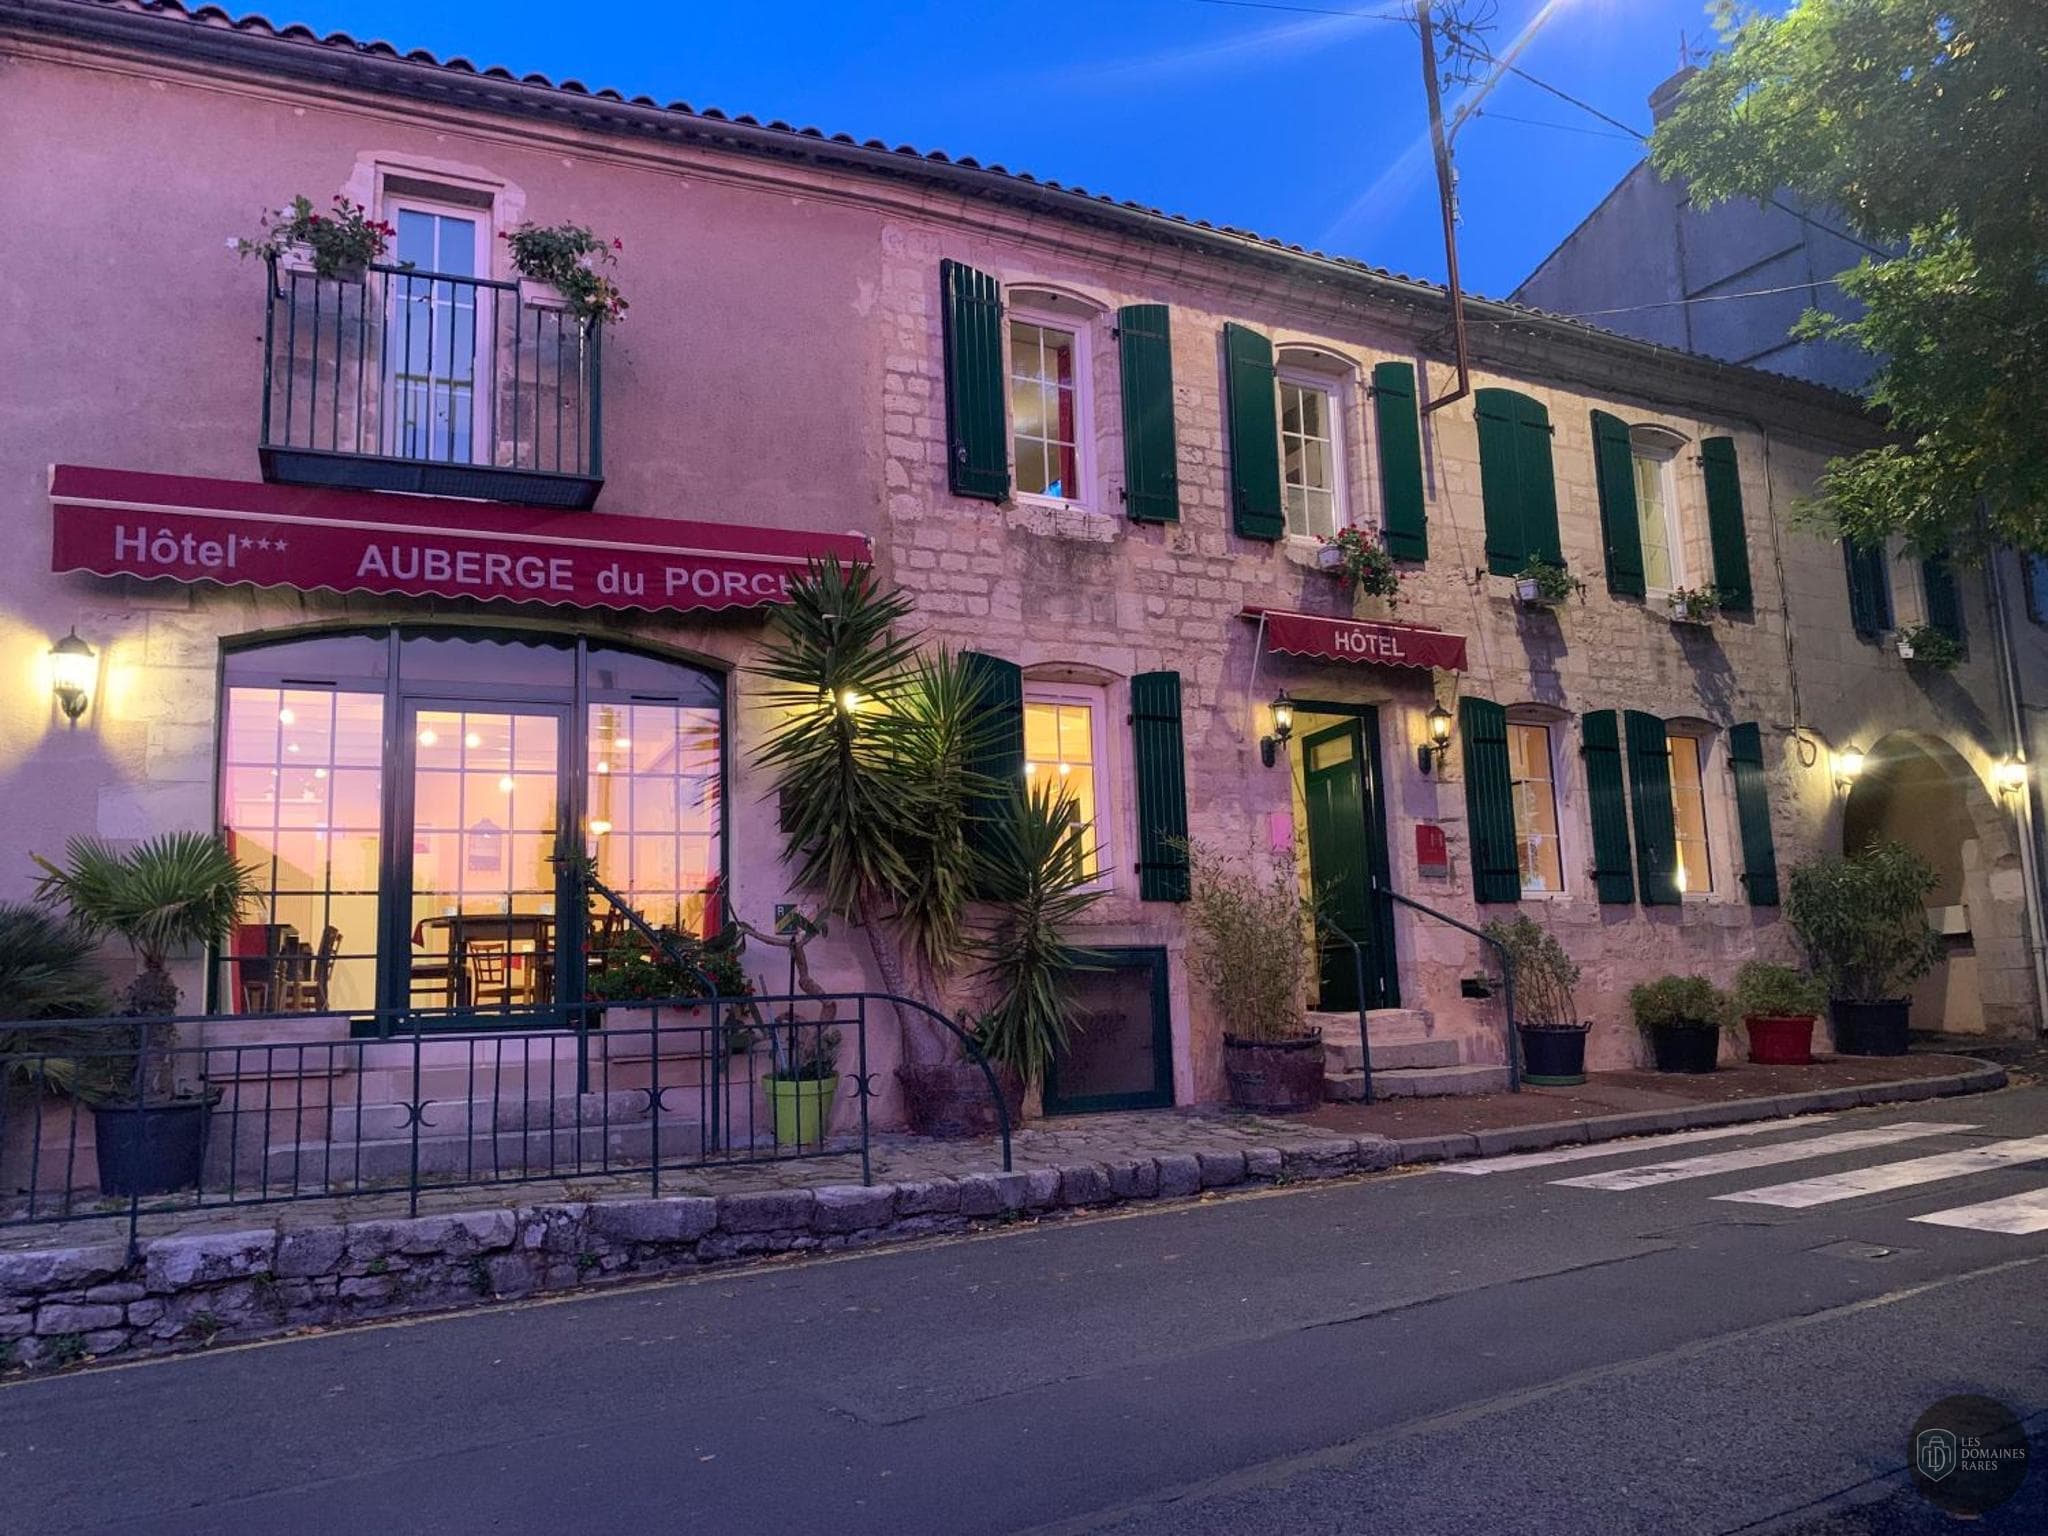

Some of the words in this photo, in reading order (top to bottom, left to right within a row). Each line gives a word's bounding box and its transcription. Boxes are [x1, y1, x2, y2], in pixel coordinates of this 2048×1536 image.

[356, 544, 574, 591] AUBERGE
[597, 563, 645, 595] du
[1335, 628, 1405, 656] HÔTEL
